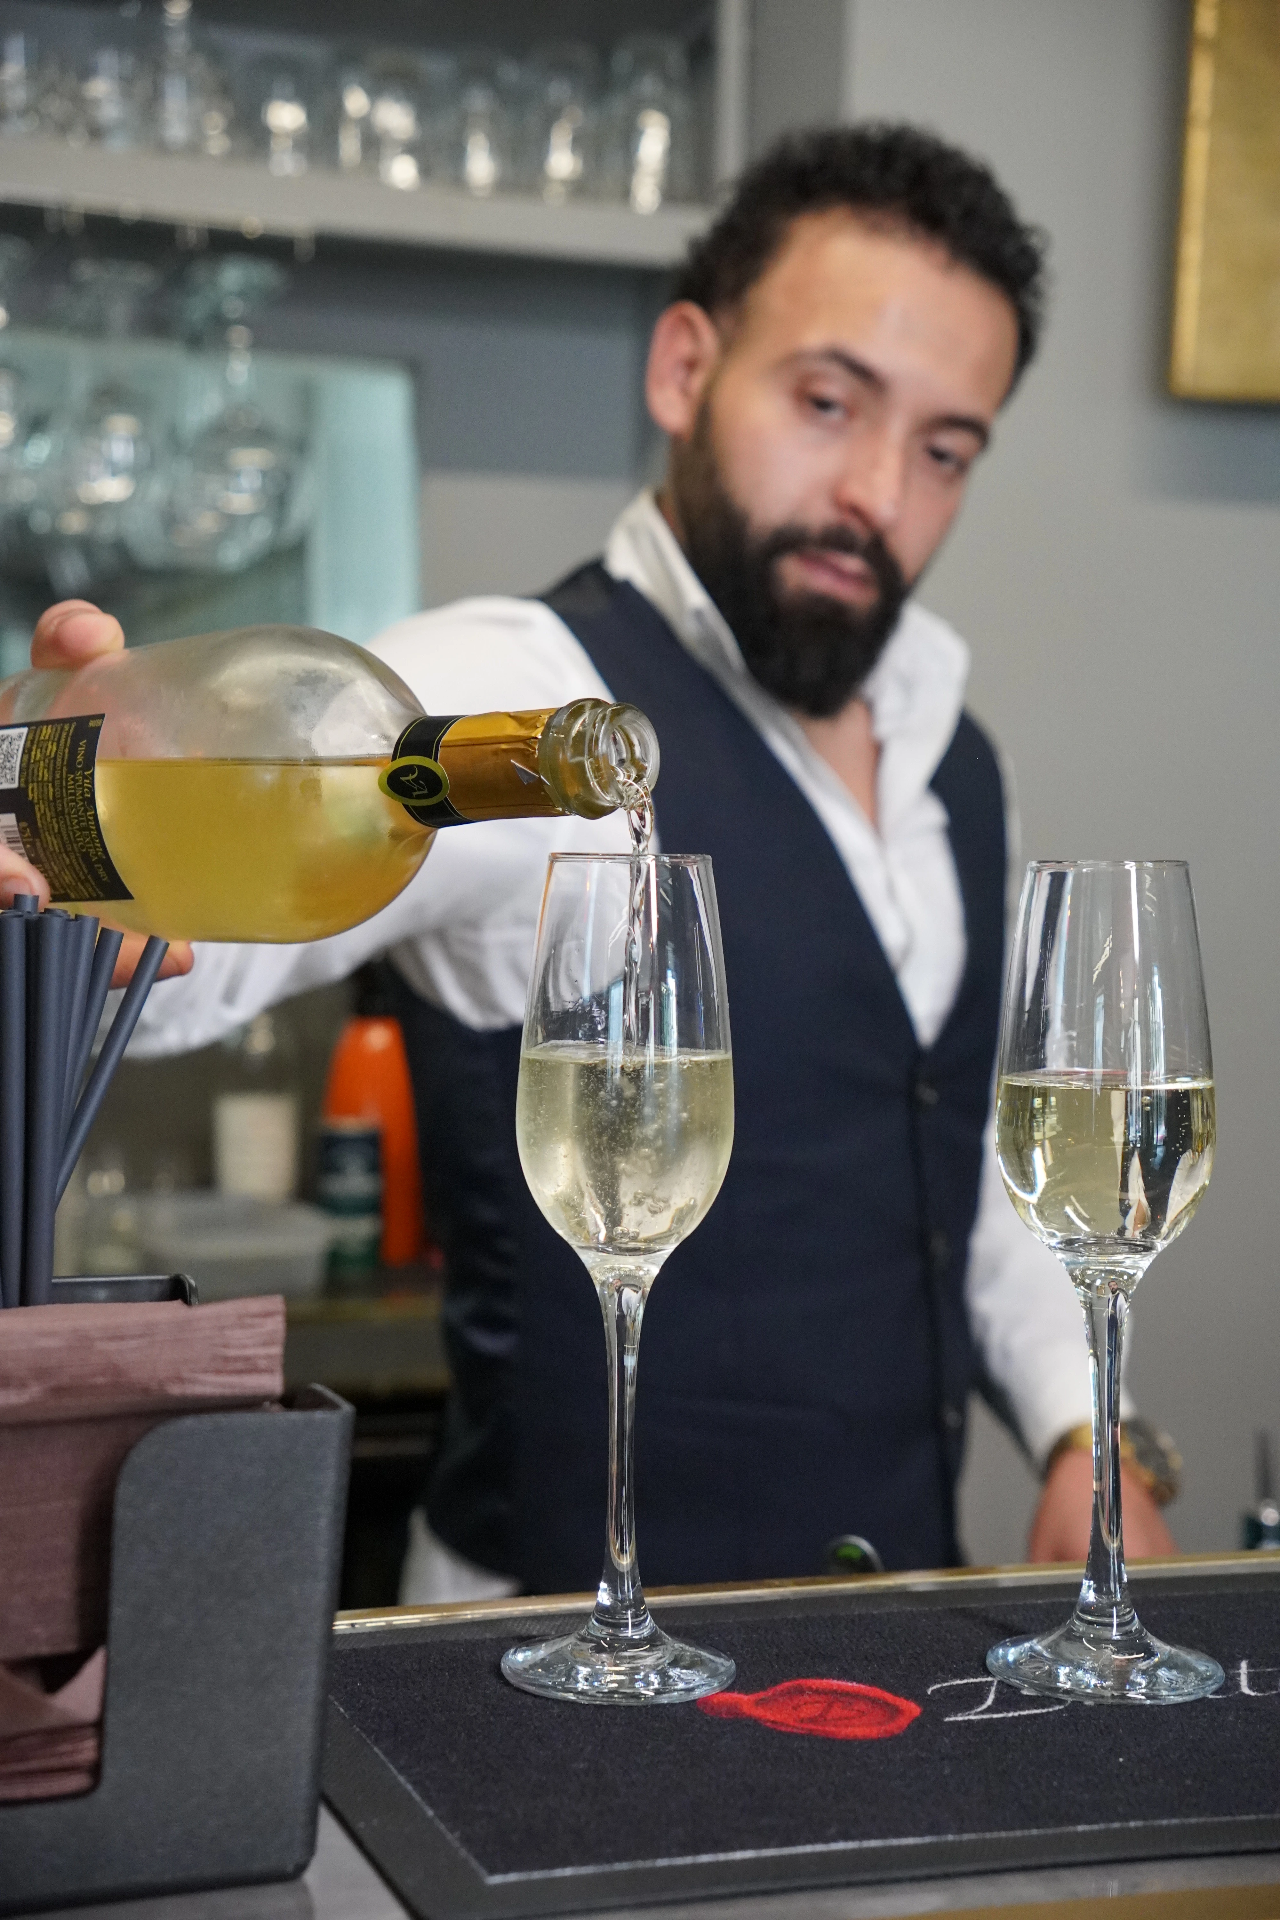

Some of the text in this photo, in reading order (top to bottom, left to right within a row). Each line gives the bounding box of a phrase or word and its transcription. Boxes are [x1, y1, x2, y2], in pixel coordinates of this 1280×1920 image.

[76, 739, 87, 768] VINO
[67, 774, 87, 852] MILLESIMATO
[75, 770, 88, 828] SPUMANTE
[82, 831, 98, 862] EXTRA
[94, 864, 110, 883] DRY
